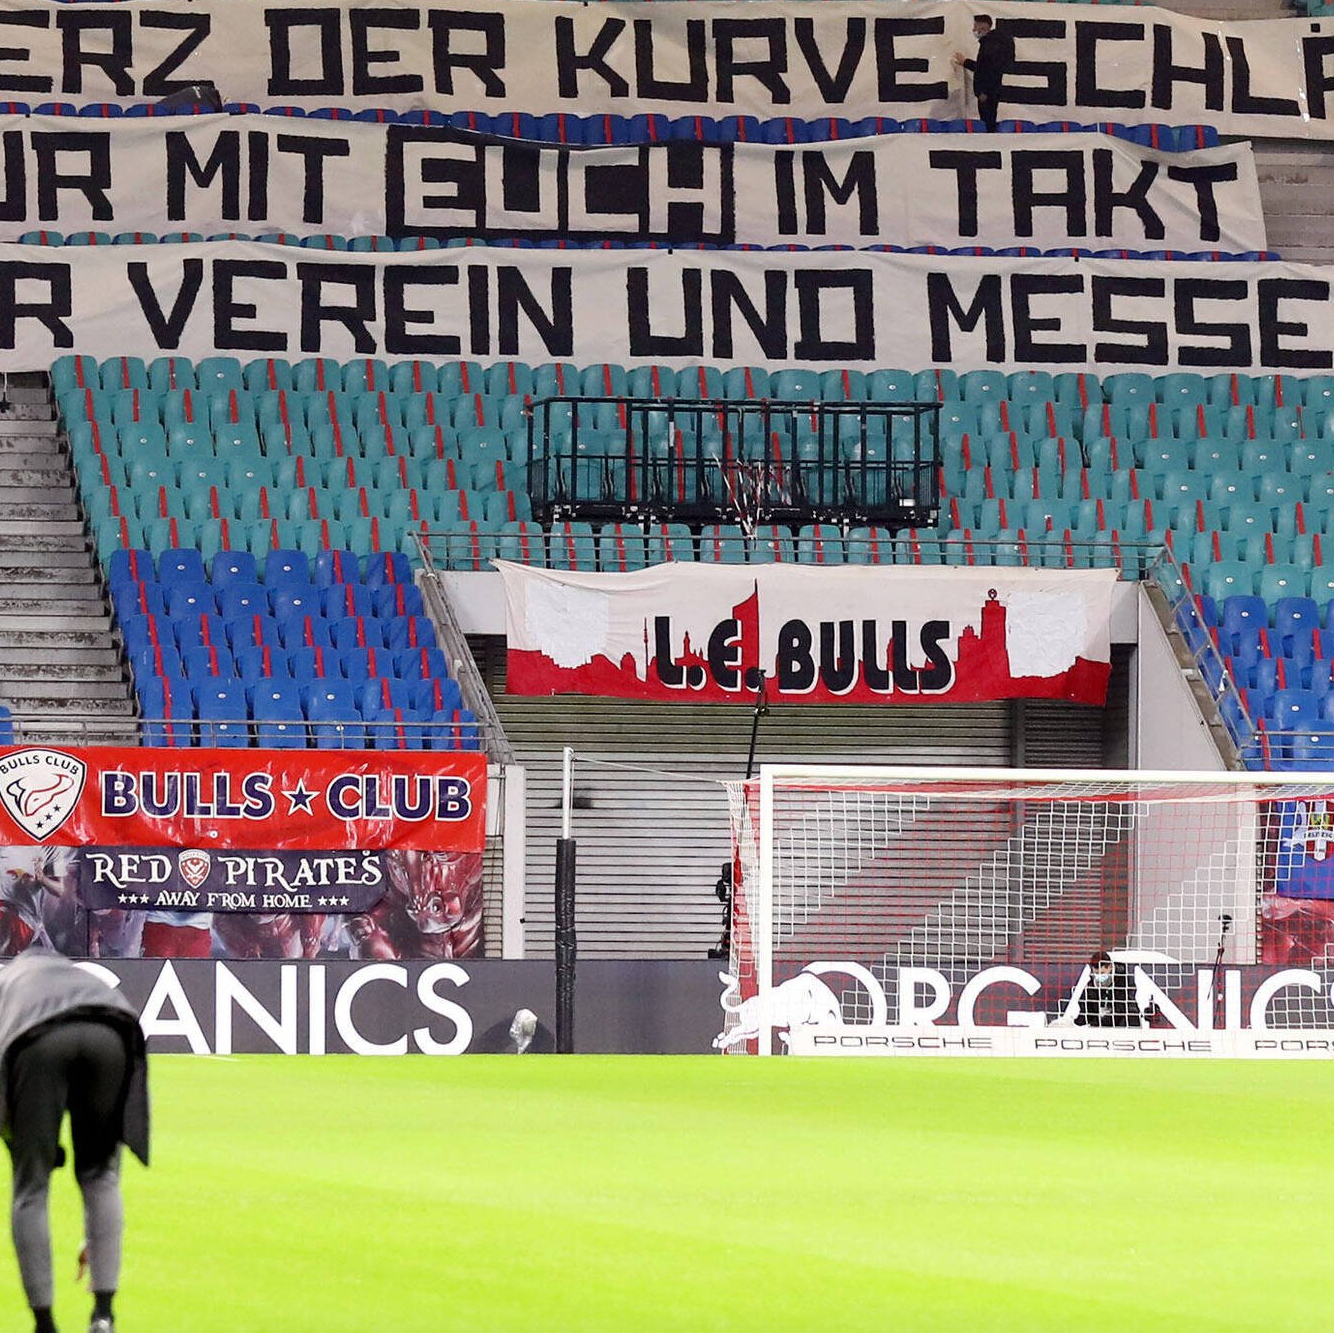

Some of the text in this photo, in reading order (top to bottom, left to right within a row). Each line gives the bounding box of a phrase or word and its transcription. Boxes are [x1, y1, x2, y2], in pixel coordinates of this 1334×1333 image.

[265, 6, 508, 98] DER
[555, 15, 950, 105] KURVE
[166, 129, 351, 225] MIT
[388, 126, 735, 242] EUCH
[774, 149, 879, 237] IM
[929, 149, 1239, 243] TAKT
[126, 257, 574, 358] VEREIN
[627, 266, 876, 361] UND
[777, 618, 957, 695] BULLS
[45, 755, 79, 775] CLUB
[101, 769, 472, 823] BULLS CLUB
[85, 849, 383, 888] RED PIRATES
[155, 891, 313, 908] AWAY FROM HOME
[812, 1034, 994, 1050] PORSCHE
[1034, 1037, 1213, 1053] PORSCHE
